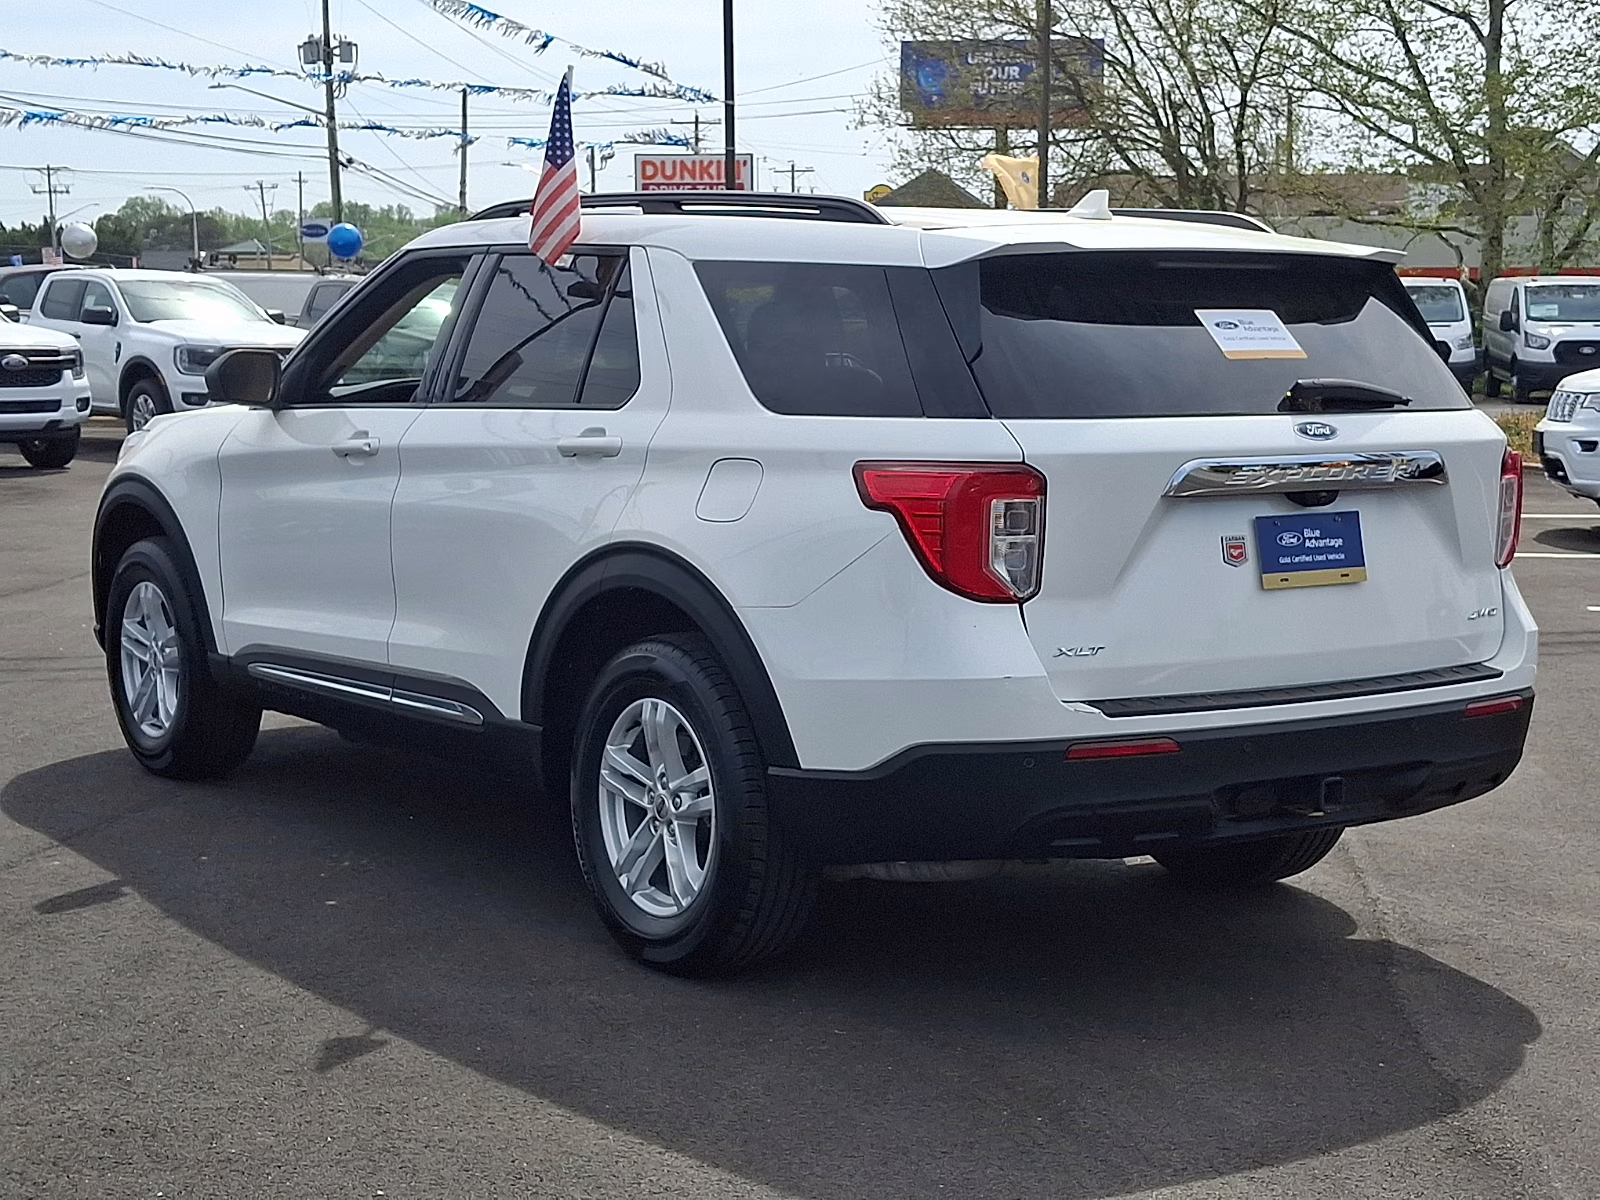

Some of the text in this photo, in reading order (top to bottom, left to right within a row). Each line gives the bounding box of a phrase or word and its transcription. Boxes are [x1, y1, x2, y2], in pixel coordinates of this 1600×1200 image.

[1224, 465, 1412, 484] EXPLORER
[1303, 527, 1320, 538] Blue
[1305, 537, 1343, 548] Advantage
[1279, 552, 1345, 564] Gold Certified Used Vehicle
[1052, 645, 1105, 657] XLT
